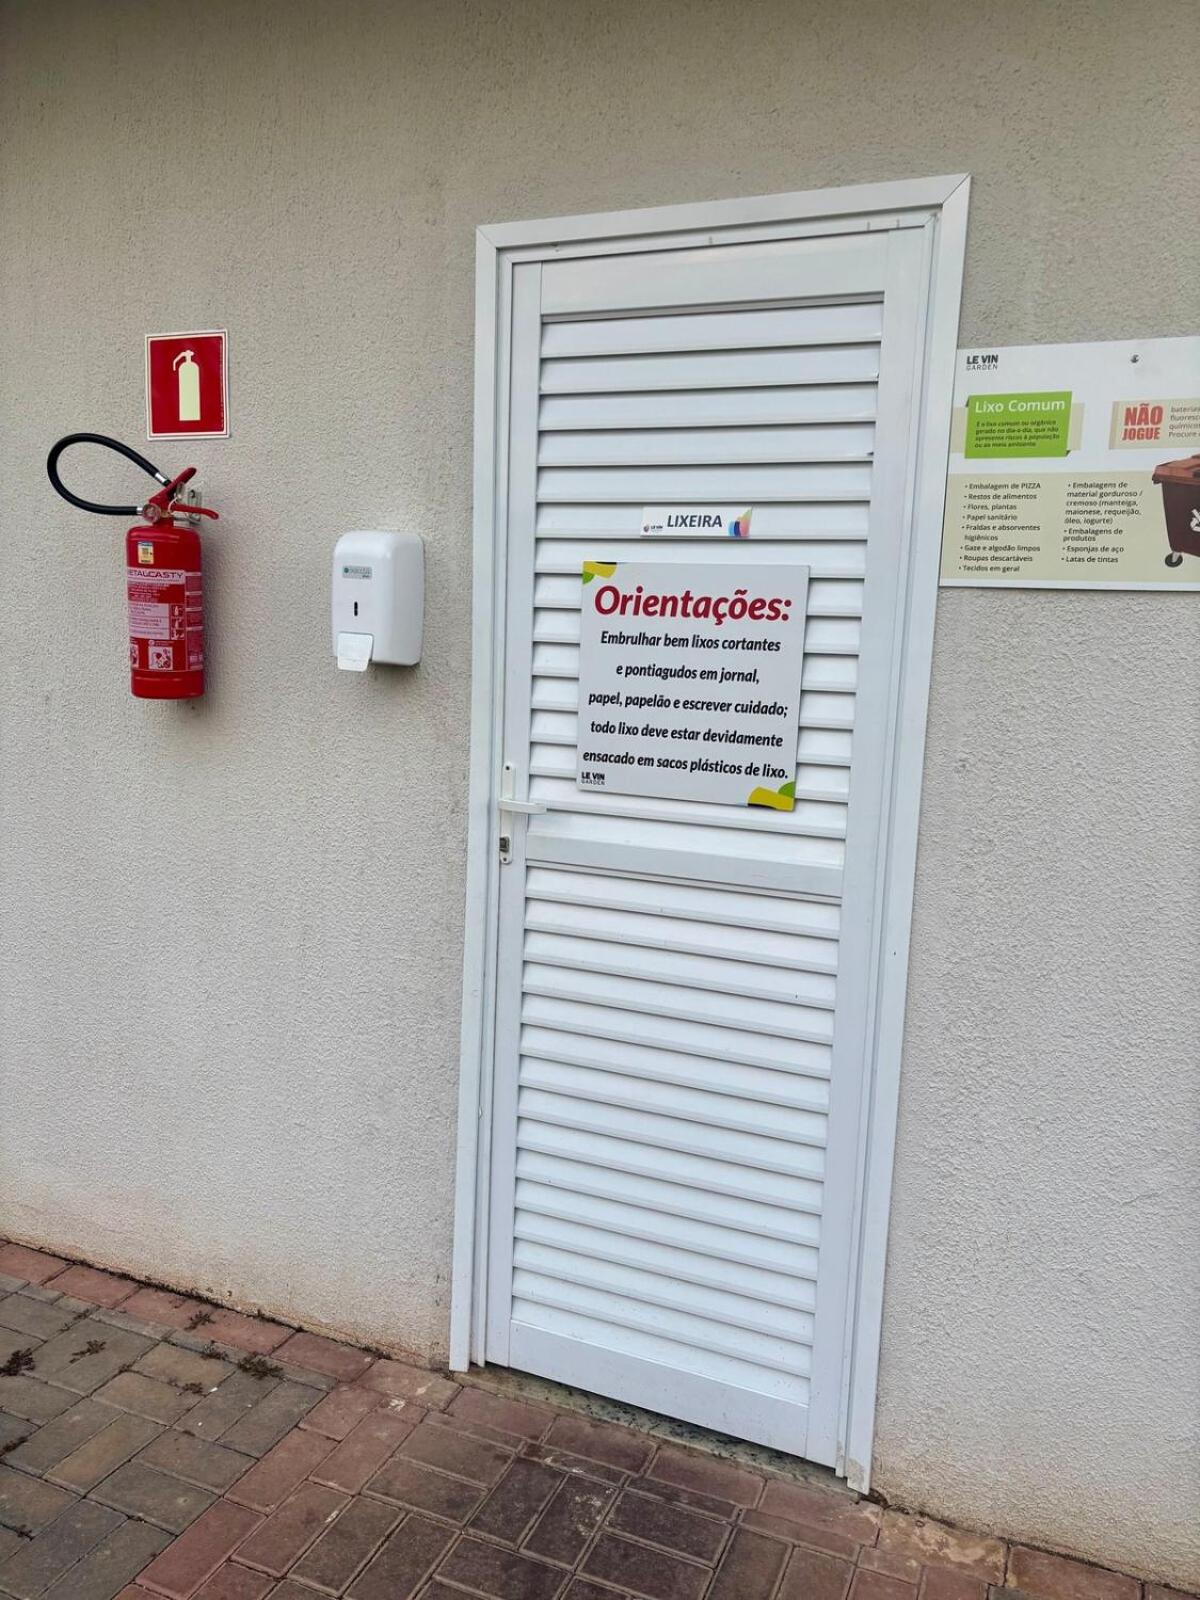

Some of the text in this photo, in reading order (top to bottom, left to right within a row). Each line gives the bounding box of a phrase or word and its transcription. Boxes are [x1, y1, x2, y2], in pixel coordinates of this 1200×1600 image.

[966, 354, 999, 364] LE VIN
[975, 400, 1065, 413] Lixo Comum
[1124, 403, 1163, 426] NÃO
[1122, 427, 1161, 440] JOGUE
[969, 483, 1009, 491] Embalagem
[1099, 490, 1138, 499] gorduroso
[667, 515, 723, 527] LIXEIRA
[966, 514, 986, 522] Papel
[1068, 528, 1112, 536] Embalagens
[964, 534, 999, 542] higiênicos
[988, 545, 1016, 553] algodão
[1066, 546, 1099, 554] Esponjas
[127, 570, 184, 579] ETALCASTY
[594, 584, 792, 625] Orientações:
[600, 630, 781, 652] Embrulhar bem lixos cortantes
[616, 663, 760, 684] e pontiagudos em jornal,
[588, 692, 788, 718] papel, papelão e escrever cuidado;
[590, 720, 783, 748] todo lixo deve estar devidamente
[583, 749, 788, 780] ensacado em sacos plásticos de lixo.
[581, 771, 605, 781] LE VIN
